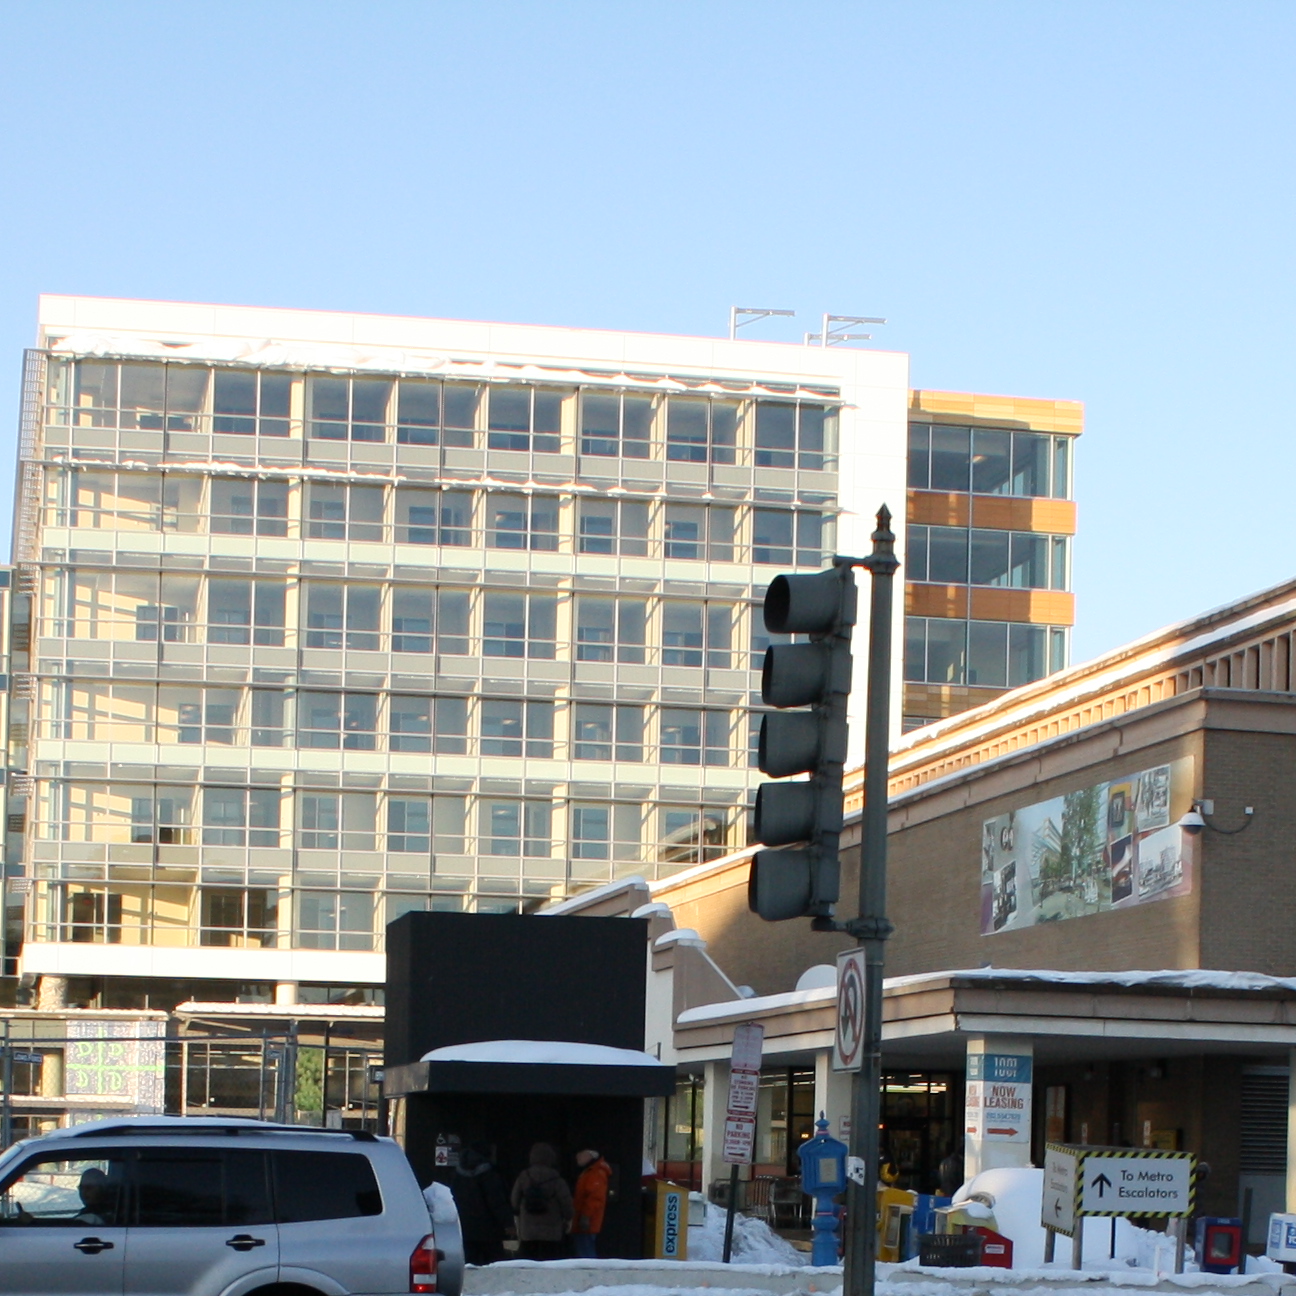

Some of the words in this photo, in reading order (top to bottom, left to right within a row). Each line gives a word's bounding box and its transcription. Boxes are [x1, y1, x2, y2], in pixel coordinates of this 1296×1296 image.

[992, 1085, 1016, 1097] NOW
[984, 1096, 1023, 1109] LEASING
[1120, 1170, 1134, 1181] To
[1137, 1171, 1174, 1182] Metro
[1118, 1187, 1178, 1199] Escalators
[665, 1195, 678, 1253] express
